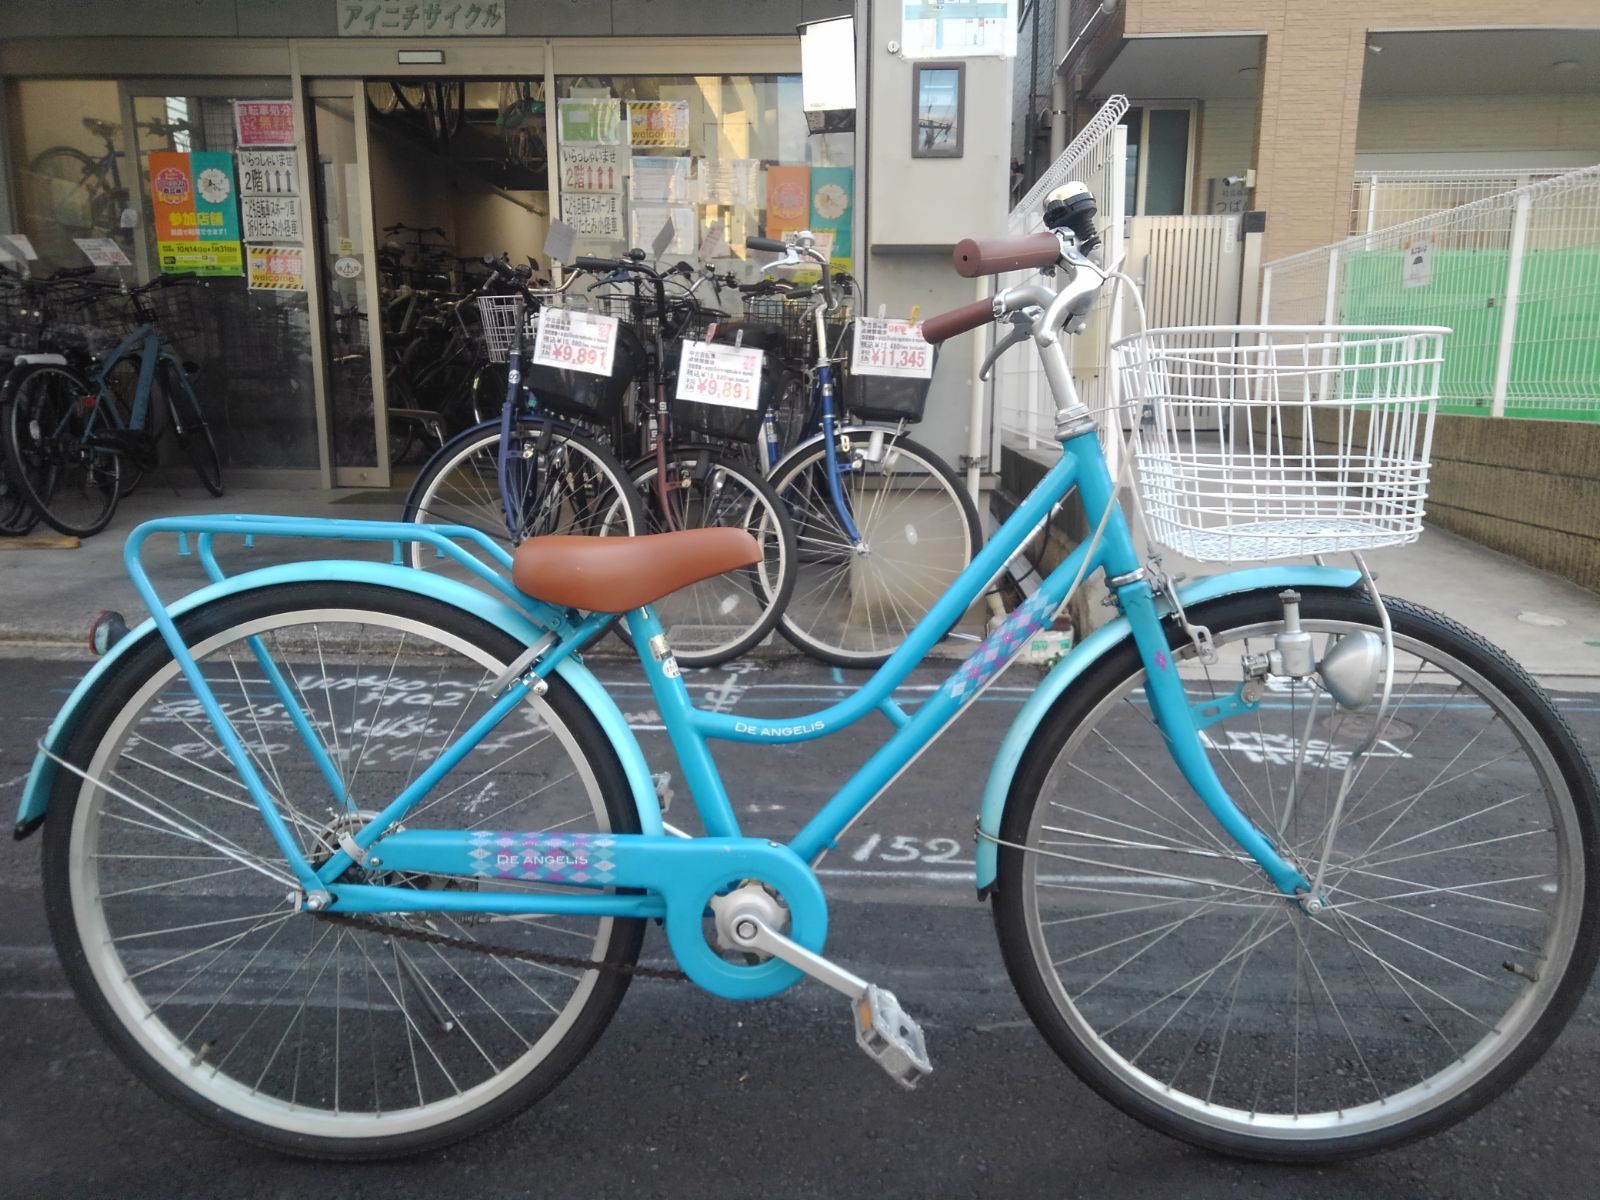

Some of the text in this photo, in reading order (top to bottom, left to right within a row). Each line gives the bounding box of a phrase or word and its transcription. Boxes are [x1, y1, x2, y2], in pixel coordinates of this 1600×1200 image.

[344, 2, 502, 31] アイニチサイクル
[241, 152, 294, 166] いらっしゃいませ
[563, 147, 616, 163] いらっしゃいませ
[245, 168, 263, 192] 2階
[566, 164, 585, 188] 2階
[871, 347, 926, 369] ¥11,345
[735, 720, 825, 737] DE ANGELIS
[852, 833, 962, 862] 152
[497, 854, 588, 865] DE ANGELIS
